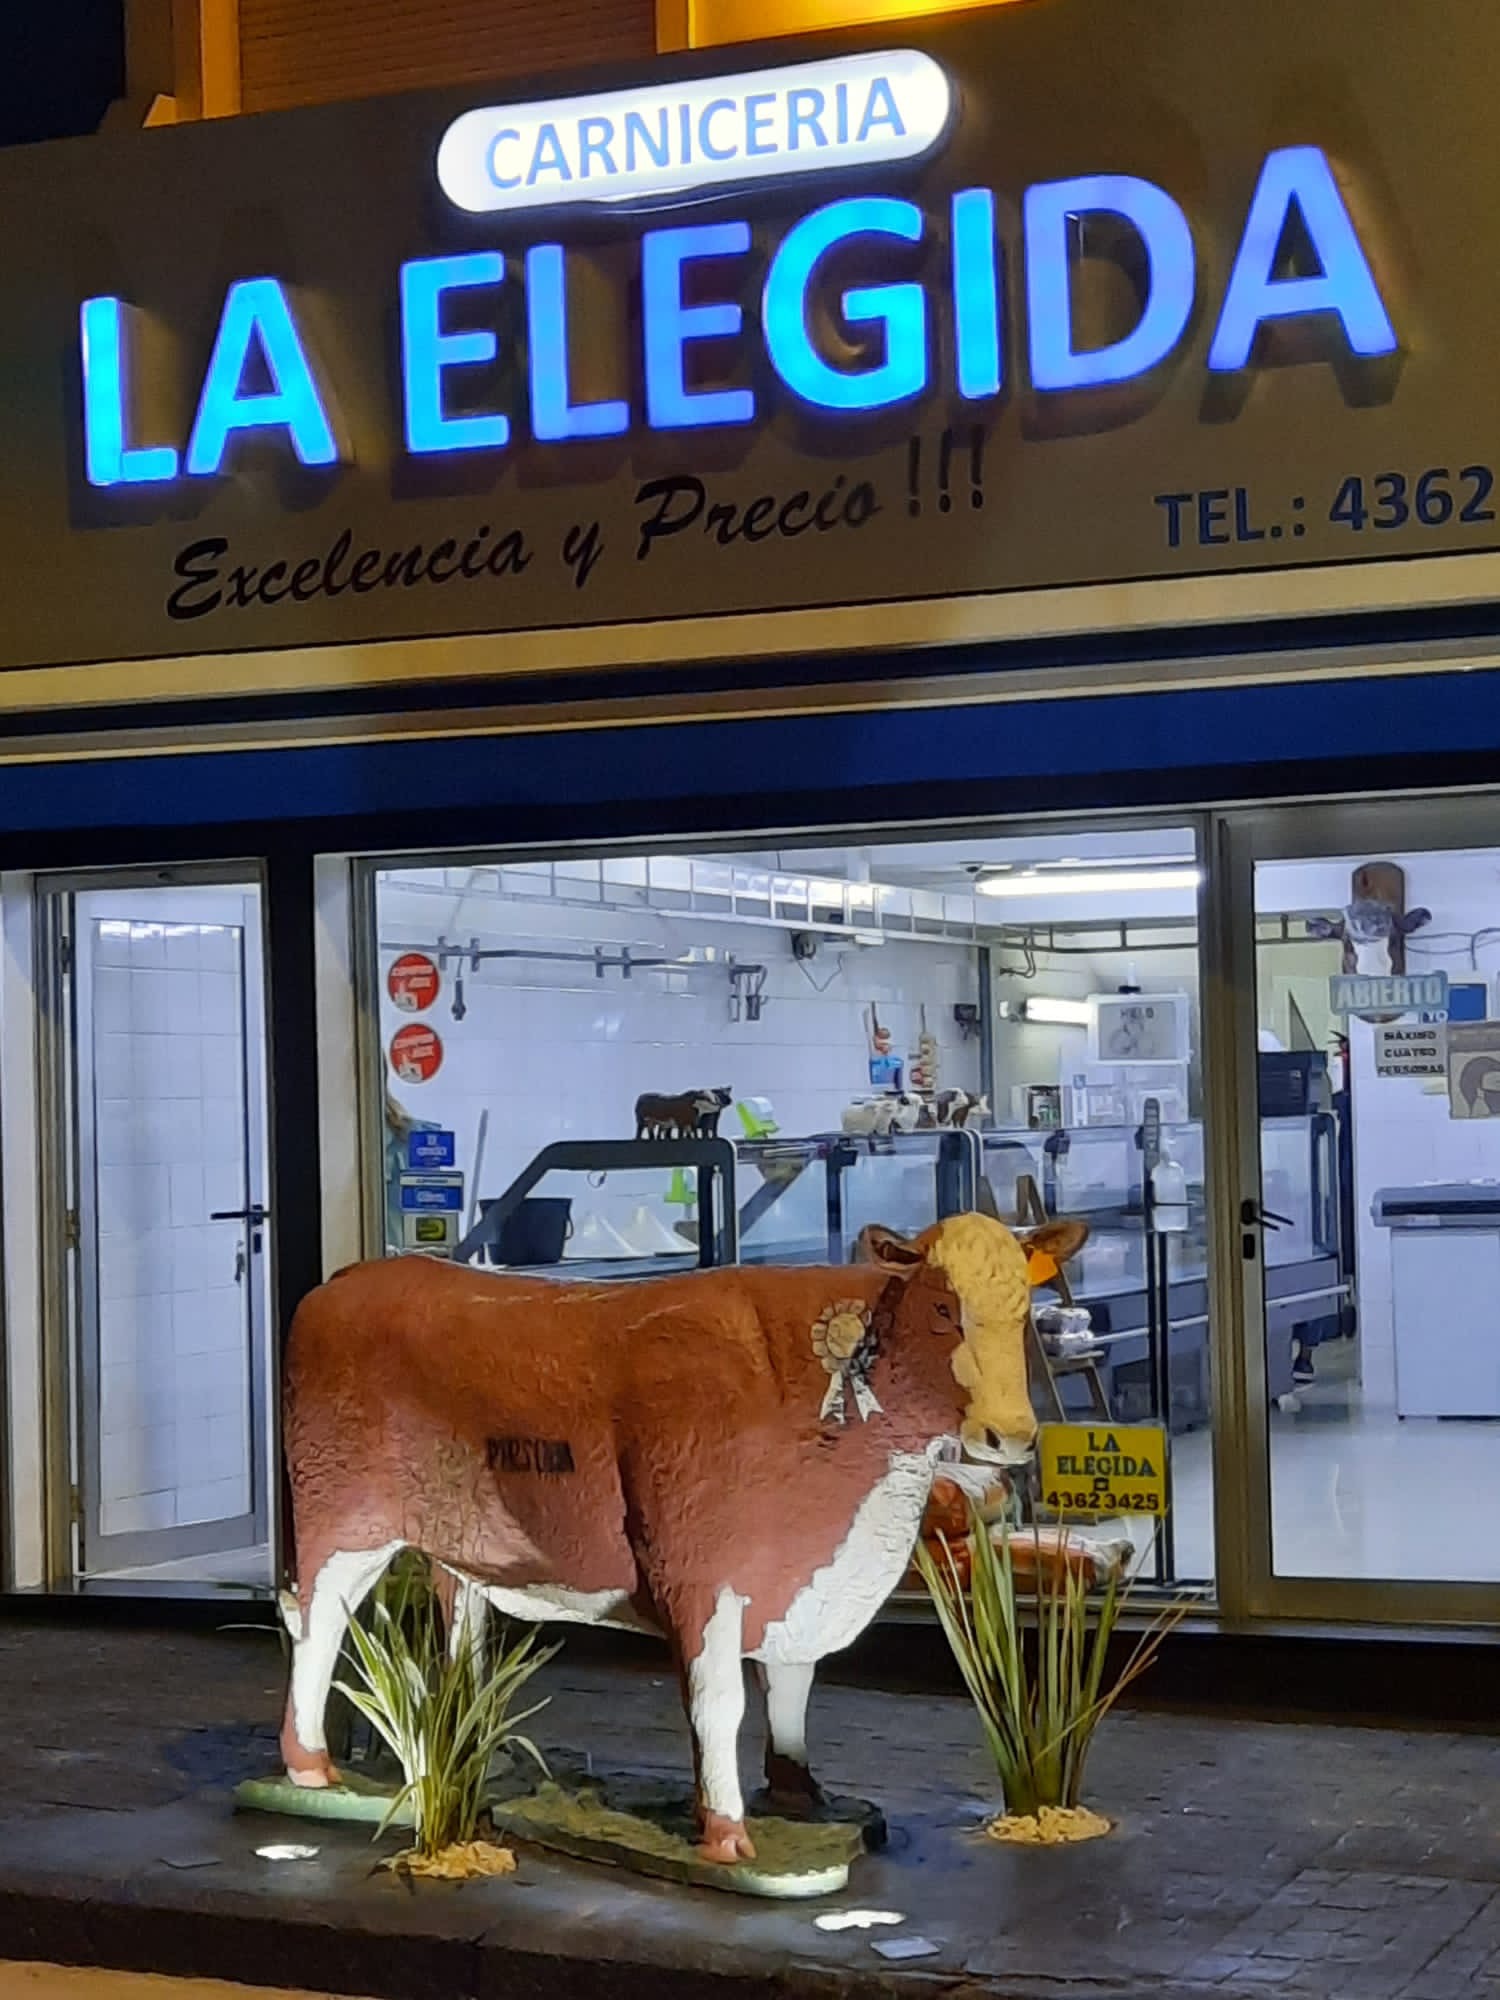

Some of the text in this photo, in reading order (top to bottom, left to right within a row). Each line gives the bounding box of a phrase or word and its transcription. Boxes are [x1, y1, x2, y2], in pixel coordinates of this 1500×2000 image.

[486, 76, 907, 189] CARNICERIA
[79, 144, 1398, 488] LA ELEGIDA
[1155, 466, 1495, 548] TEL.: 4362
[167, 525, 531, 620] Excelencia
[562, 521, 603, 588] y
[634, 475, 883, 561] Precio
[1336, 977, 1442, 1009] ABIERTO
[1383, 1047, 1437, 1058] CUATRO
[1056, 1456, 1157, 1477] ELEGIDA
[1087, 1432, 1121, 1453] LA
